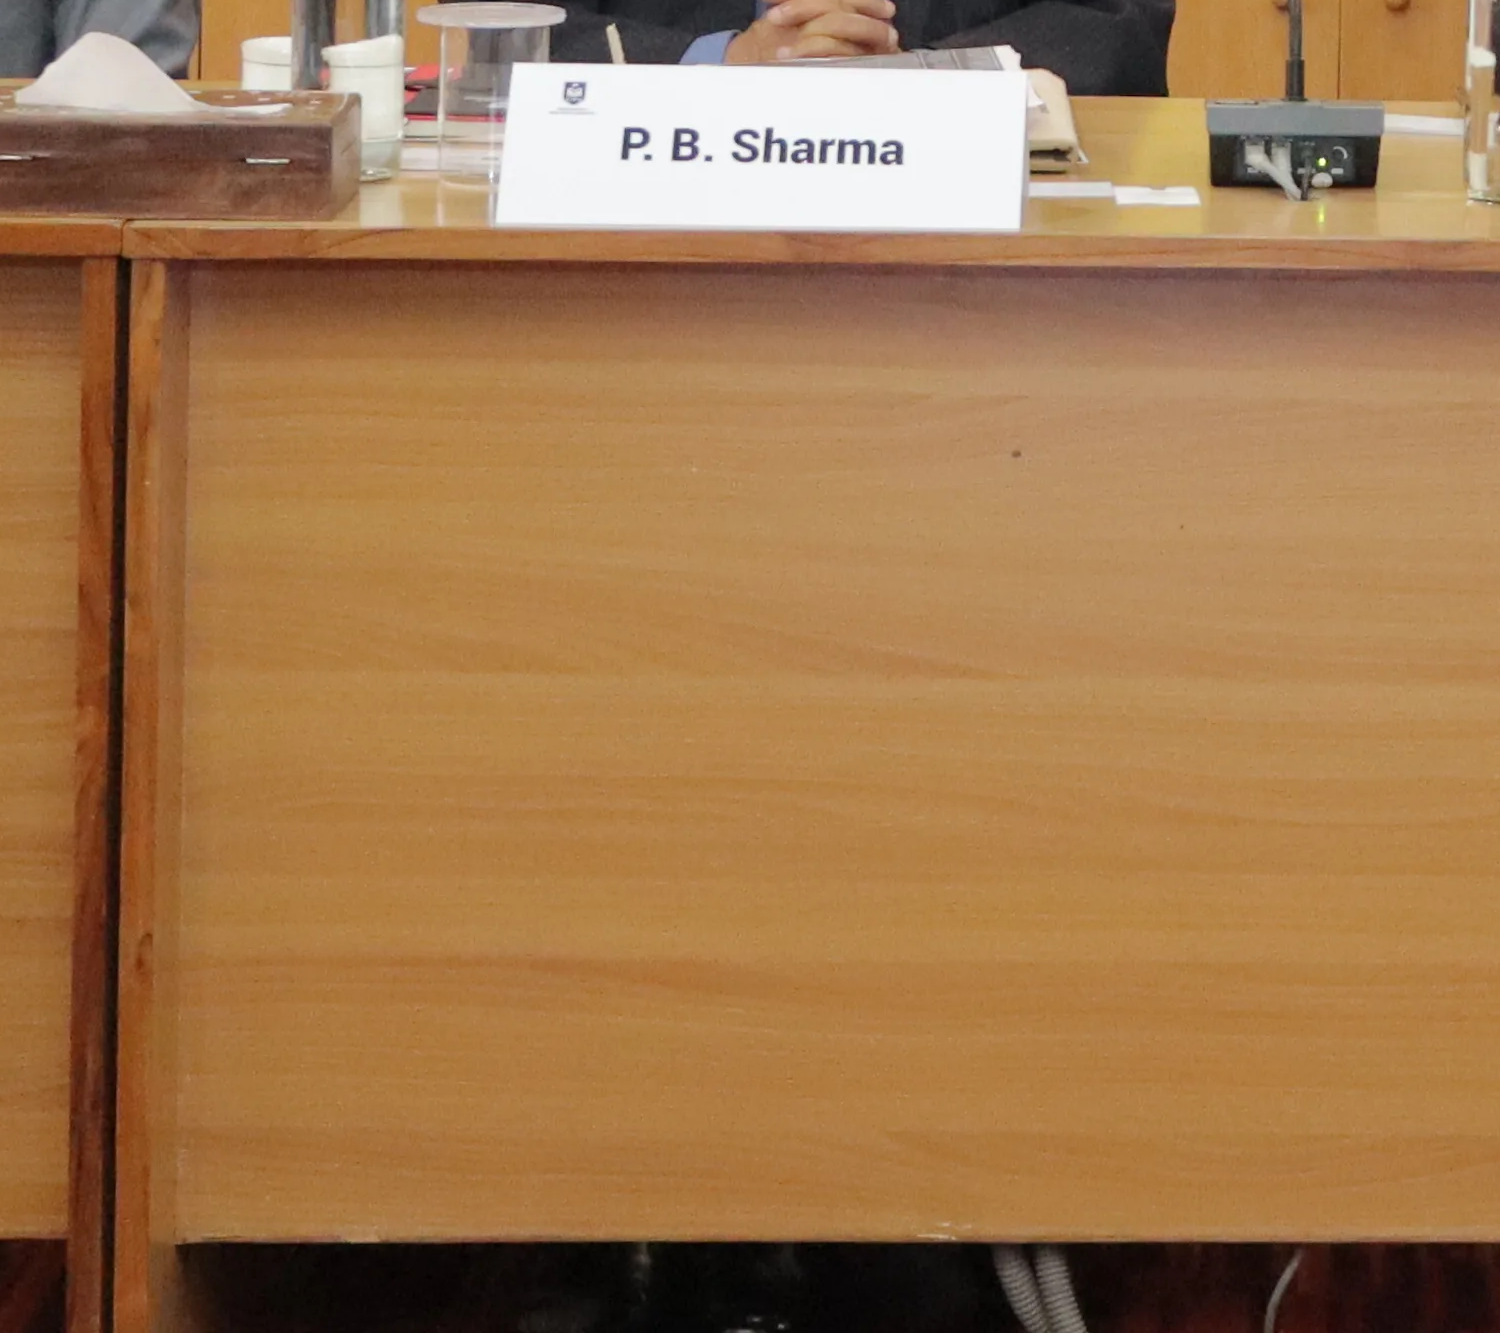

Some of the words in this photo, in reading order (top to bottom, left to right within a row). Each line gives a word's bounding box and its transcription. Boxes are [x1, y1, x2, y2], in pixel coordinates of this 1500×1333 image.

[620, 126, 653, 162] P.
[671, 127, 713, 163] B.
[731, 127, 905, 166] Sharma
